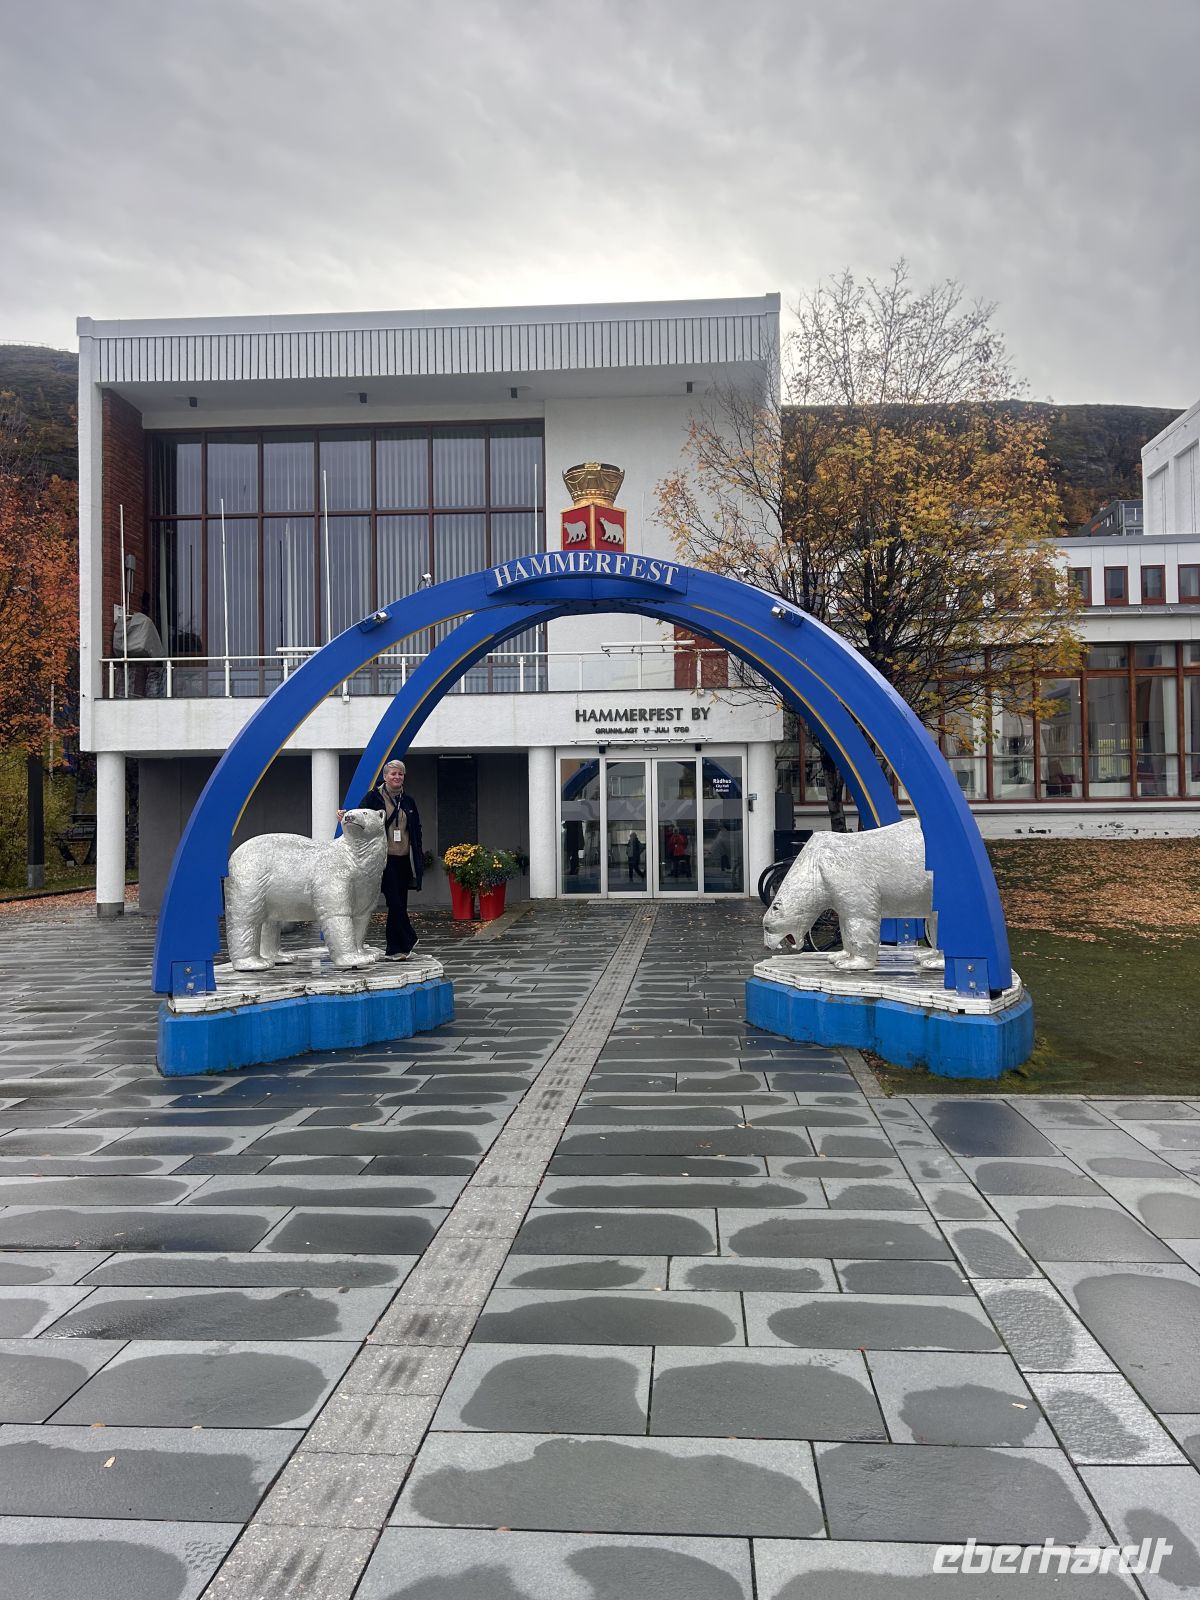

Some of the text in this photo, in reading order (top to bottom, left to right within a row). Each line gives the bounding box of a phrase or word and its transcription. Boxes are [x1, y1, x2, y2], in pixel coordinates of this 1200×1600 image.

[493, 552, 679, 588] HAMMERFEST
[575, 707, 710, 722] HAMMERFEST BY
[654, 726, 669, 734] JULI
